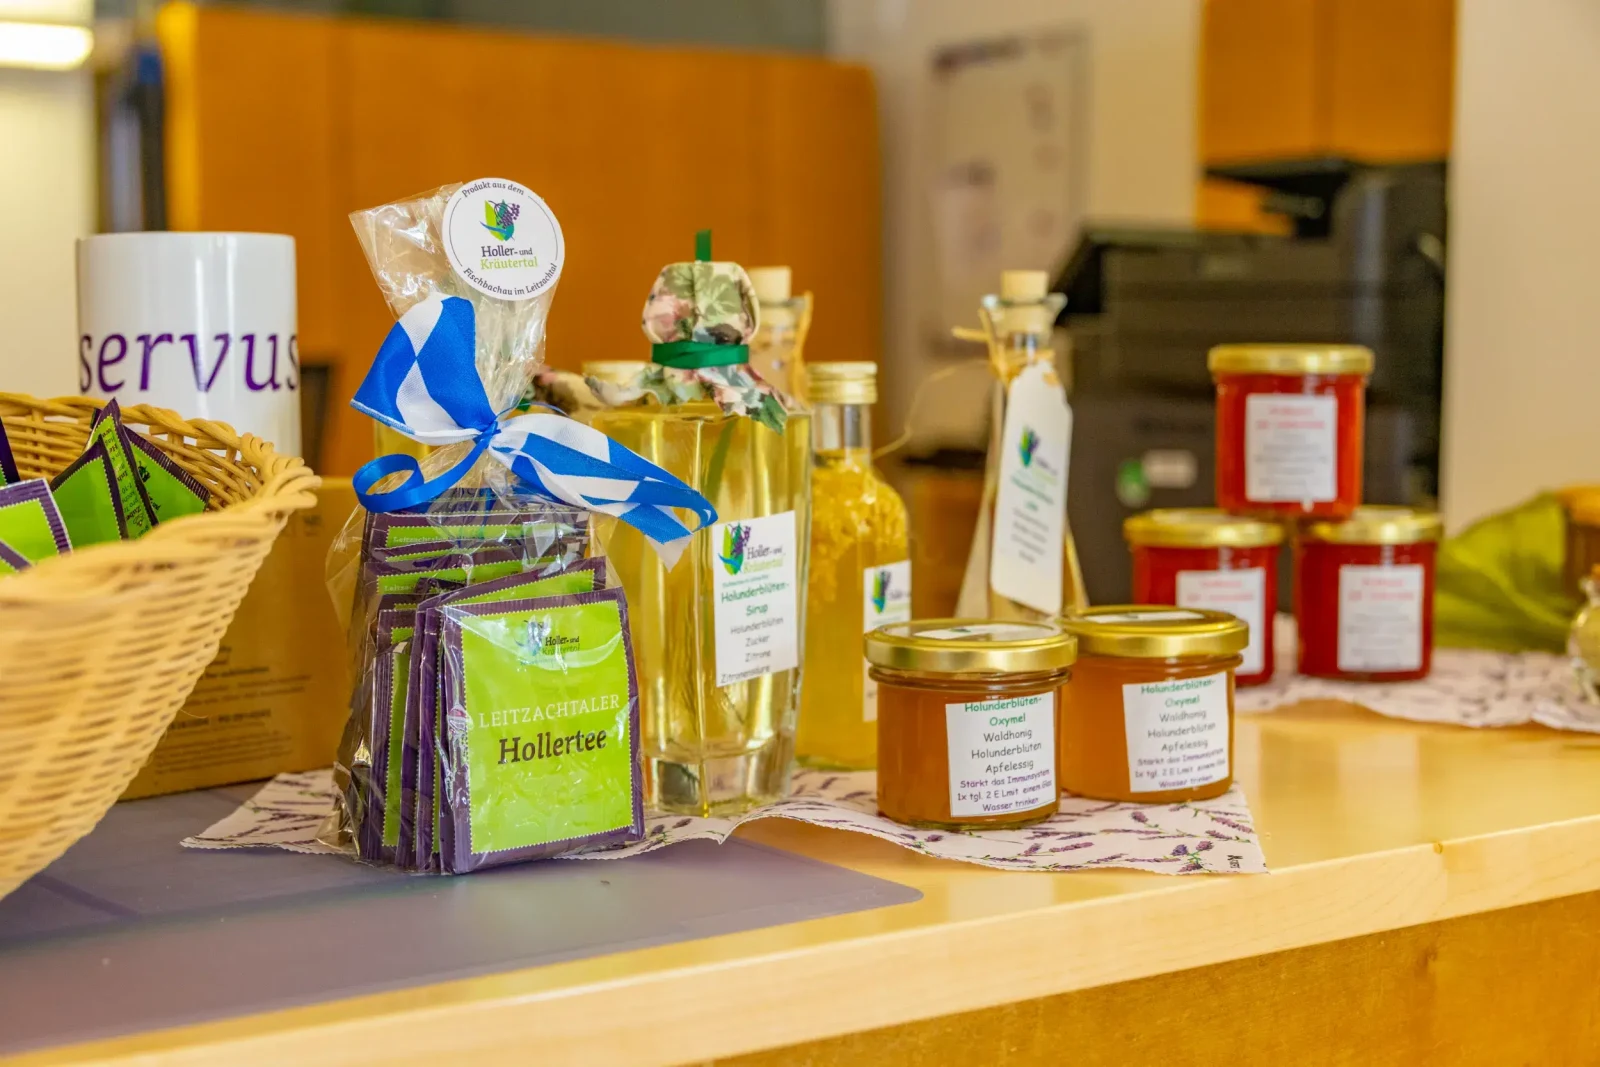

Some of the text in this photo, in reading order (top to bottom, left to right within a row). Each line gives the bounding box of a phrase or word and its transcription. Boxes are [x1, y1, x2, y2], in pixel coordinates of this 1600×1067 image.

[462, 182, 524, 197] Produkt aus dem
[481, 245, 533, 257] Holler- und
[480, 256, 538, 270] Kräutertal
[463, 262, 558, 295] Fischbachau im Leitzachtal
[80, 333, 298, 394] servus
[721, 581, 790, 604] Holunderblüten-
[746, 603, 769, 617] Sirup
[569, 635, 580, 644] und
[745, 634, 770, 648] Zucker
[745, 649, 772, 663] Zitrone
[965, 696, 1041, 712] Holunderblüten-
[479, 694, 620, 729] LEITZACHTALER
[1159, 710, 1207, 722] Waldhonig
[989, 713, 1026, 727] Oxymel
[983, 729, 1032, 742] Waldhonig
[497, 729, 607, 765] Hollertee
[1161, 740, 1208, 754] Apfelessig
[985, 760, 1034, 775] Apfelessig
[991, 778, 1005, 786] das
[957, 793, 967, 801] 1x
[986, 791, 992, 799] 2
[982, 802, 1013, 812] Wasser
